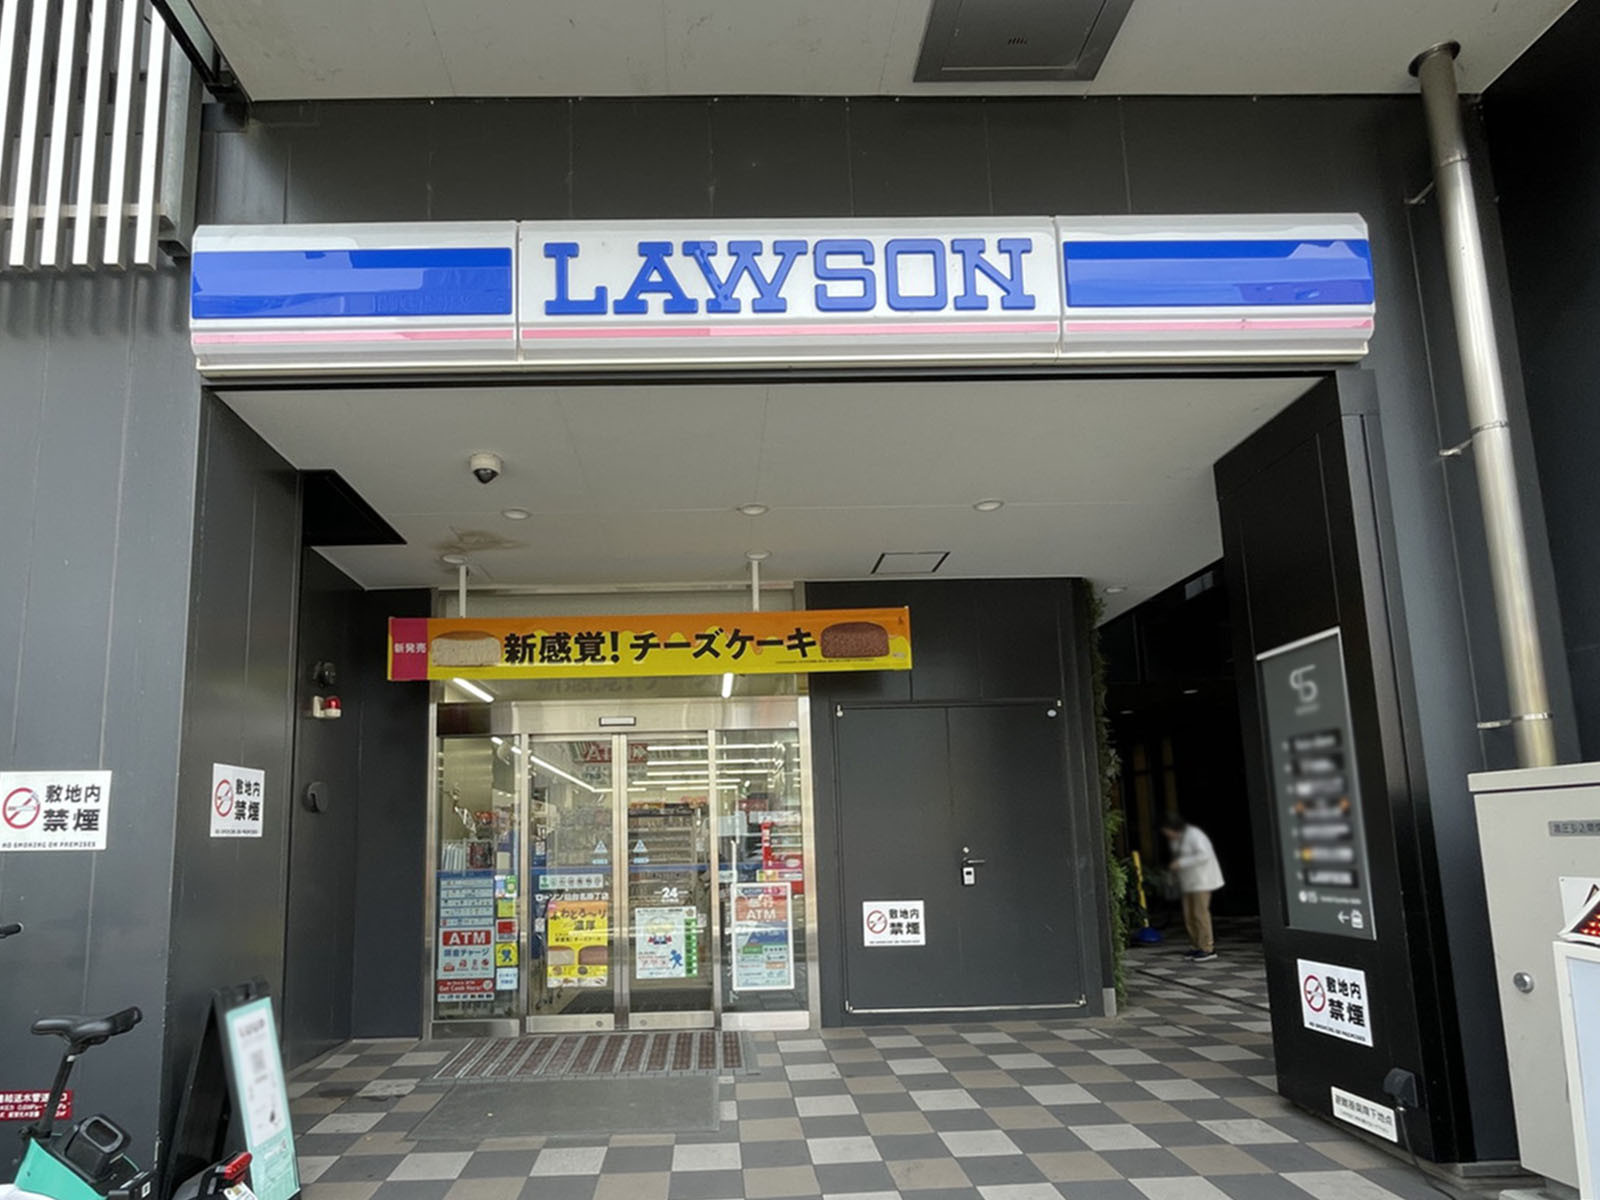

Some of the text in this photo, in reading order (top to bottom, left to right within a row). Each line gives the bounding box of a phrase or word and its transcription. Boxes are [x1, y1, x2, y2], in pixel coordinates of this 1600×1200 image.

[544, 238, 1035, 314] LAWSON
[504, 627, 816, 664] 新感覚!チーズケーキ
[45, 784, 101, 803] 敷地内
[236, 779, 260, 797] 敷地内
[43, 808, 100, 832] 禁煙
[235, 800, 260, 821] 禁煙
[746, 909, 776, 920] ATM
[889, 908, 919, 919] 敷地内
[449, 932, 486, 944] ATM
[890, 922, 920, 935] 禁煙
[1326, 976, 1361, 1000] 敷地内
[1328, 998, 1365, 1028] 禁煙
